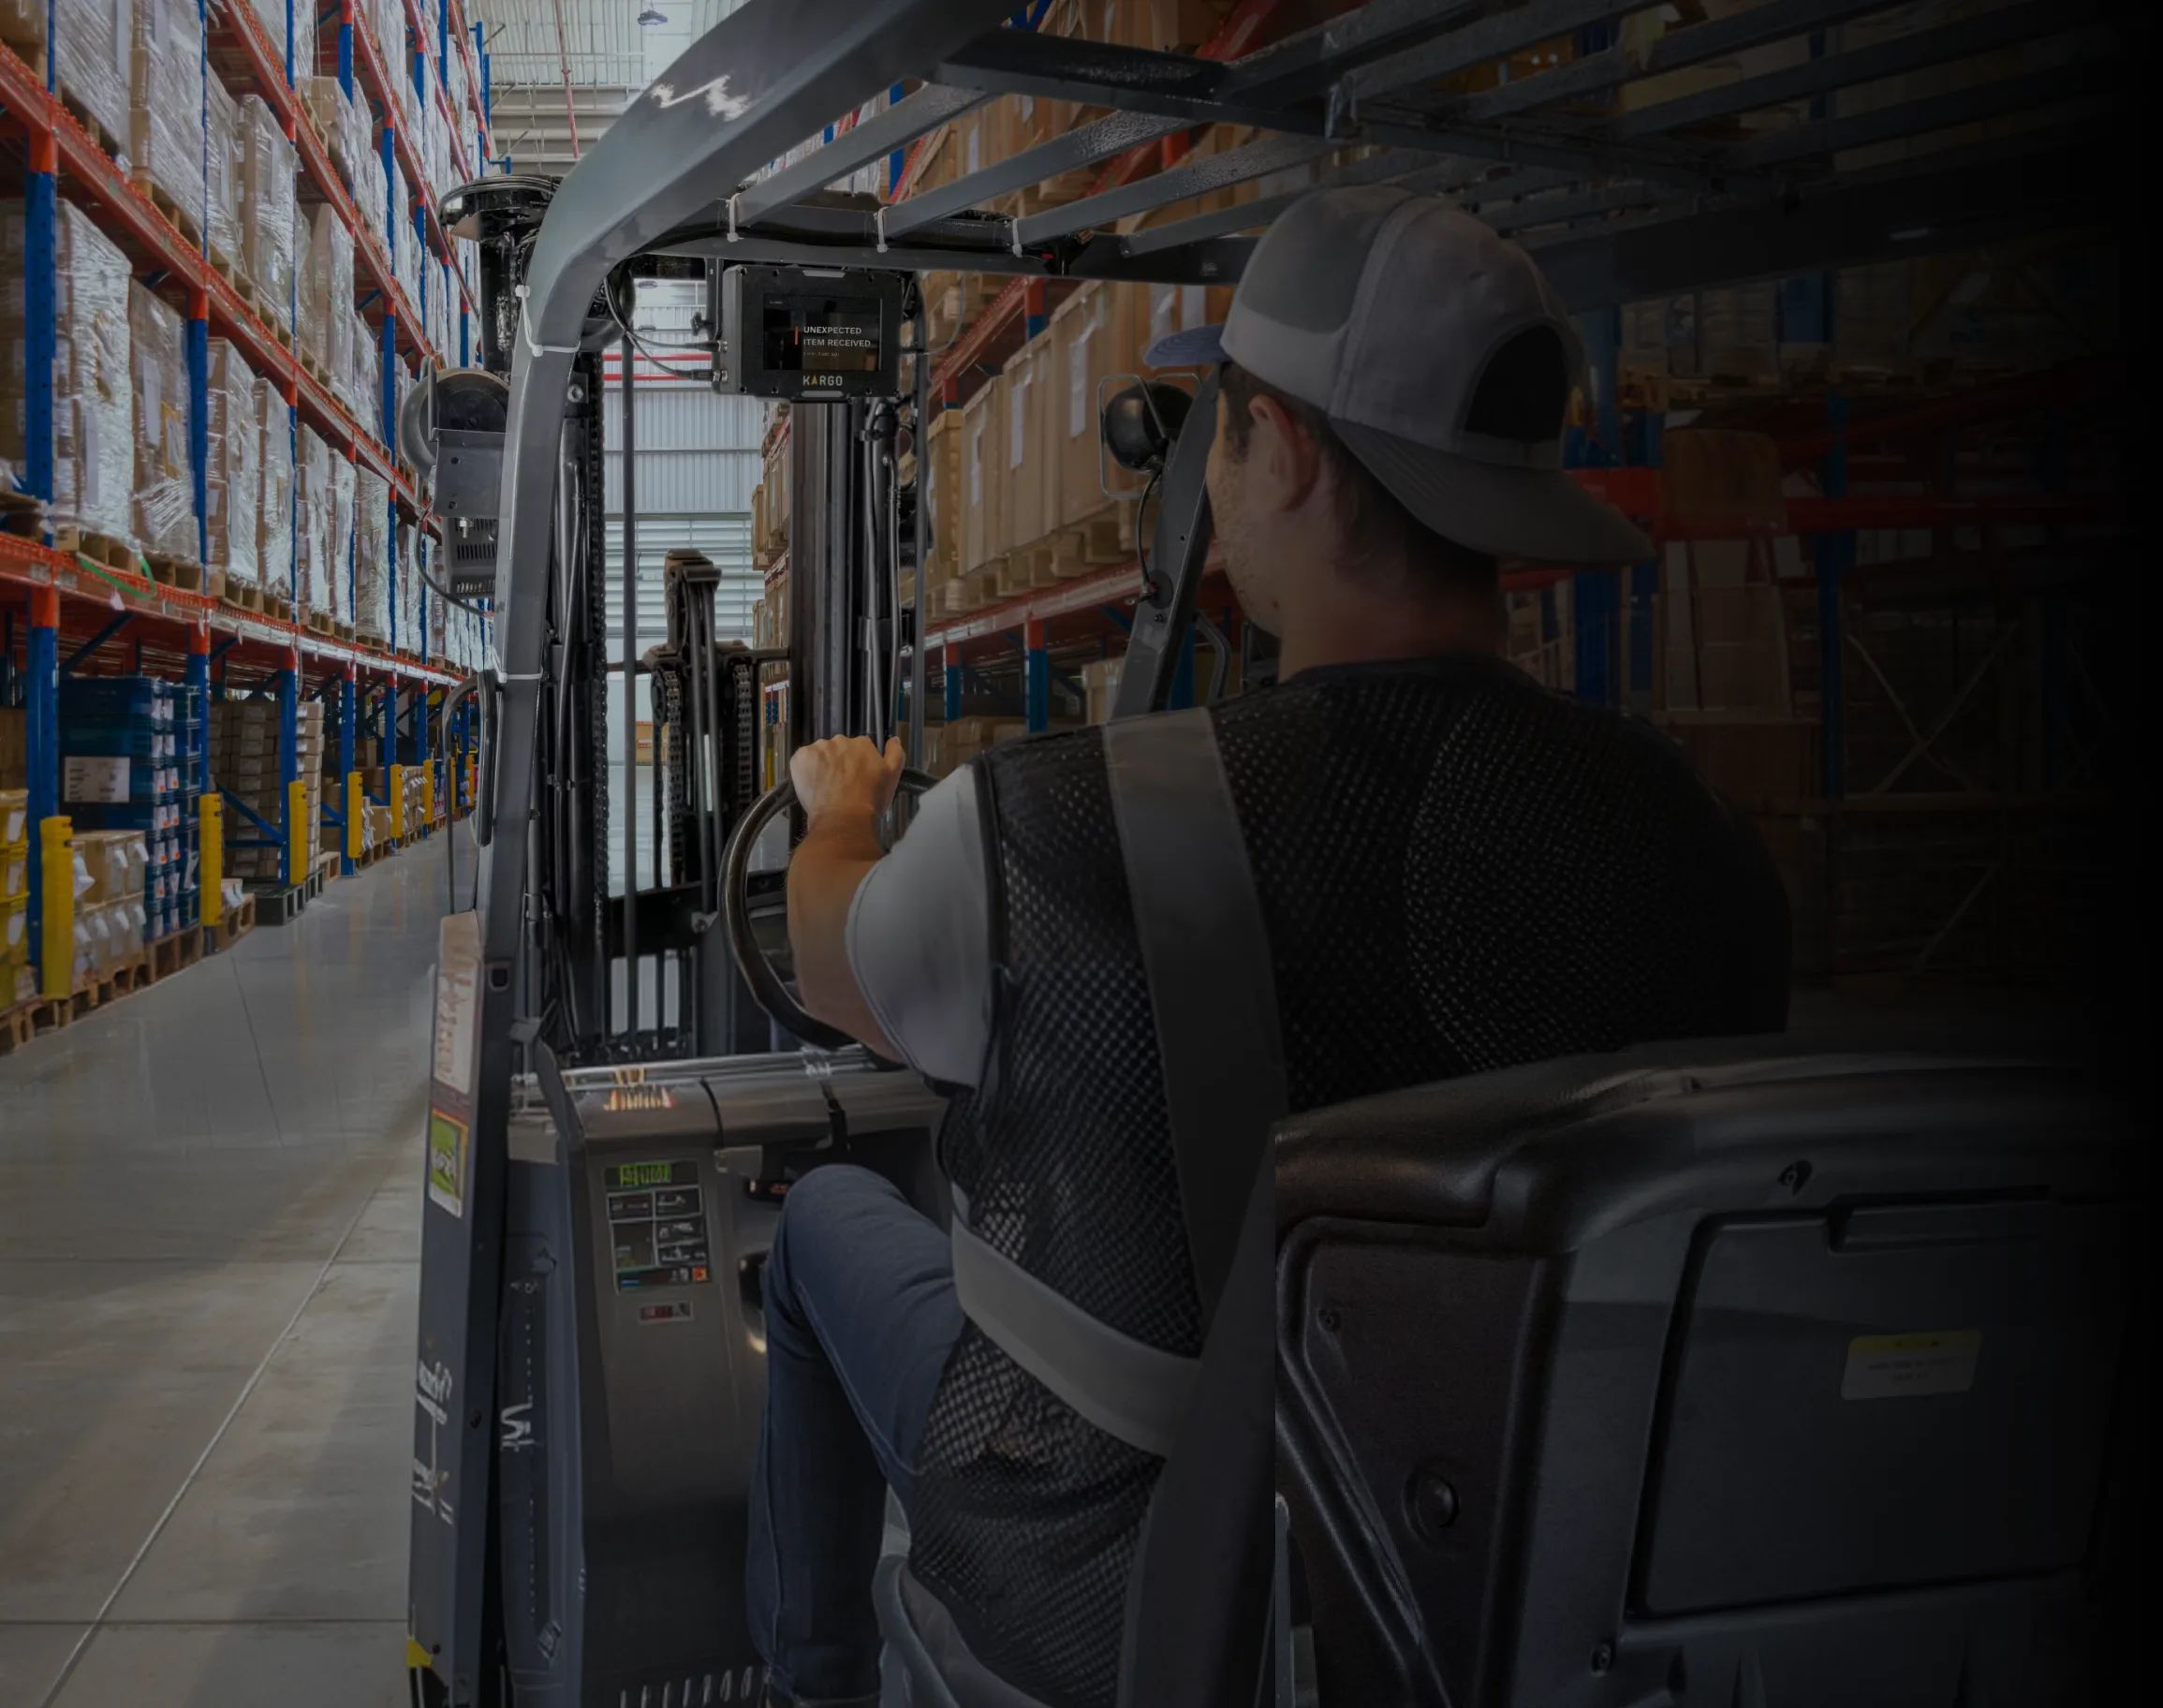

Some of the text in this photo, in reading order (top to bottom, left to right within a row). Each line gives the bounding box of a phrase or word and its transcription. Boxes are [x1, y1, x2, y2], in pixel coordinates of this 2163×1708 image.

[803, 326, 862, 334] UNEXPECTED
[828, 339, 871, 347] RECEIVED
[802, 375, 843, 386] KARGO
